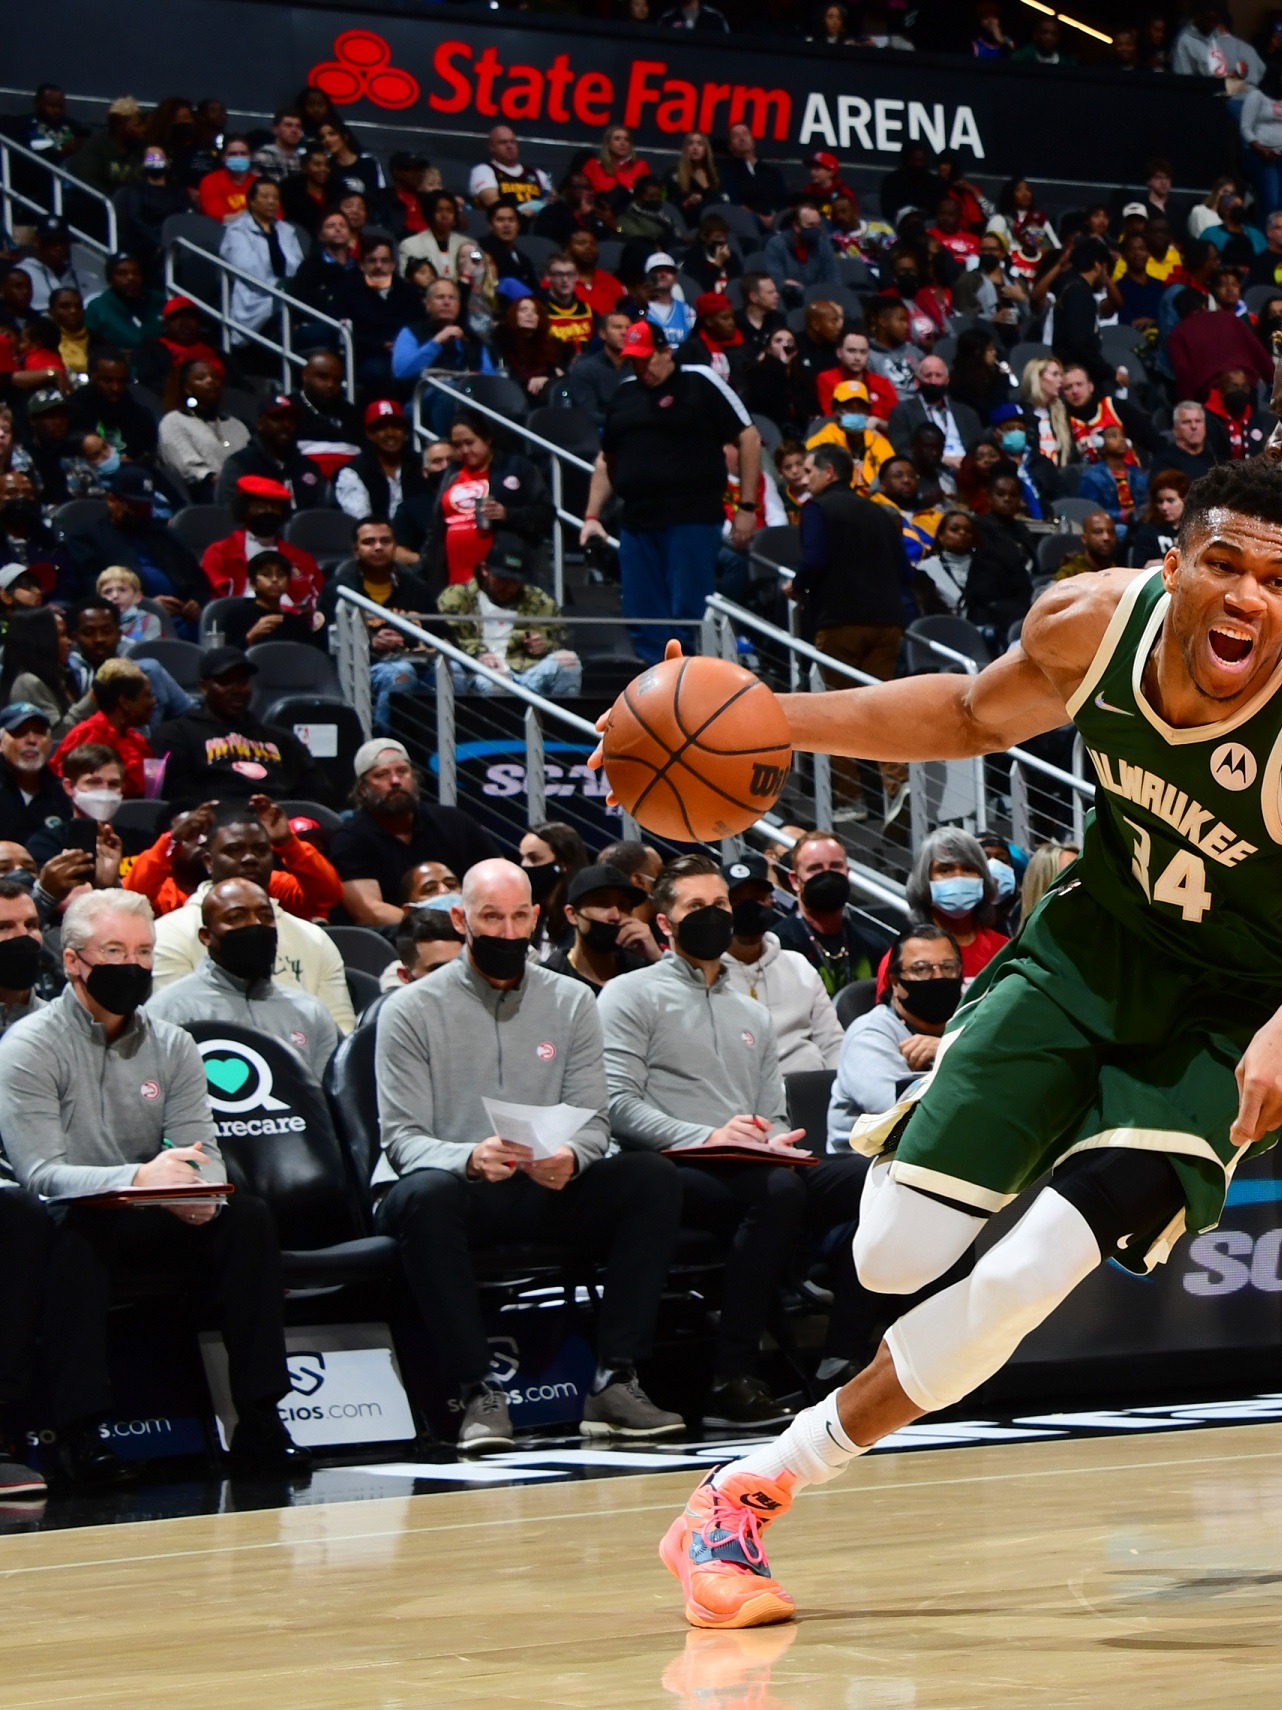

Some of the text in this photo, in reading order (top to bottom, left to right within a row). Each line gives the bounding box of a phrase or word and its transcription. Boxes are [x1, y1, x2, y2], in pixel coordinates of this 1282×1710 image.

[428, 40, 986, 160] State Farm ARENA
[1085, 745, 1259, 868] ILWAUKEE
[276, 1402, 383, 1422] cios.com
